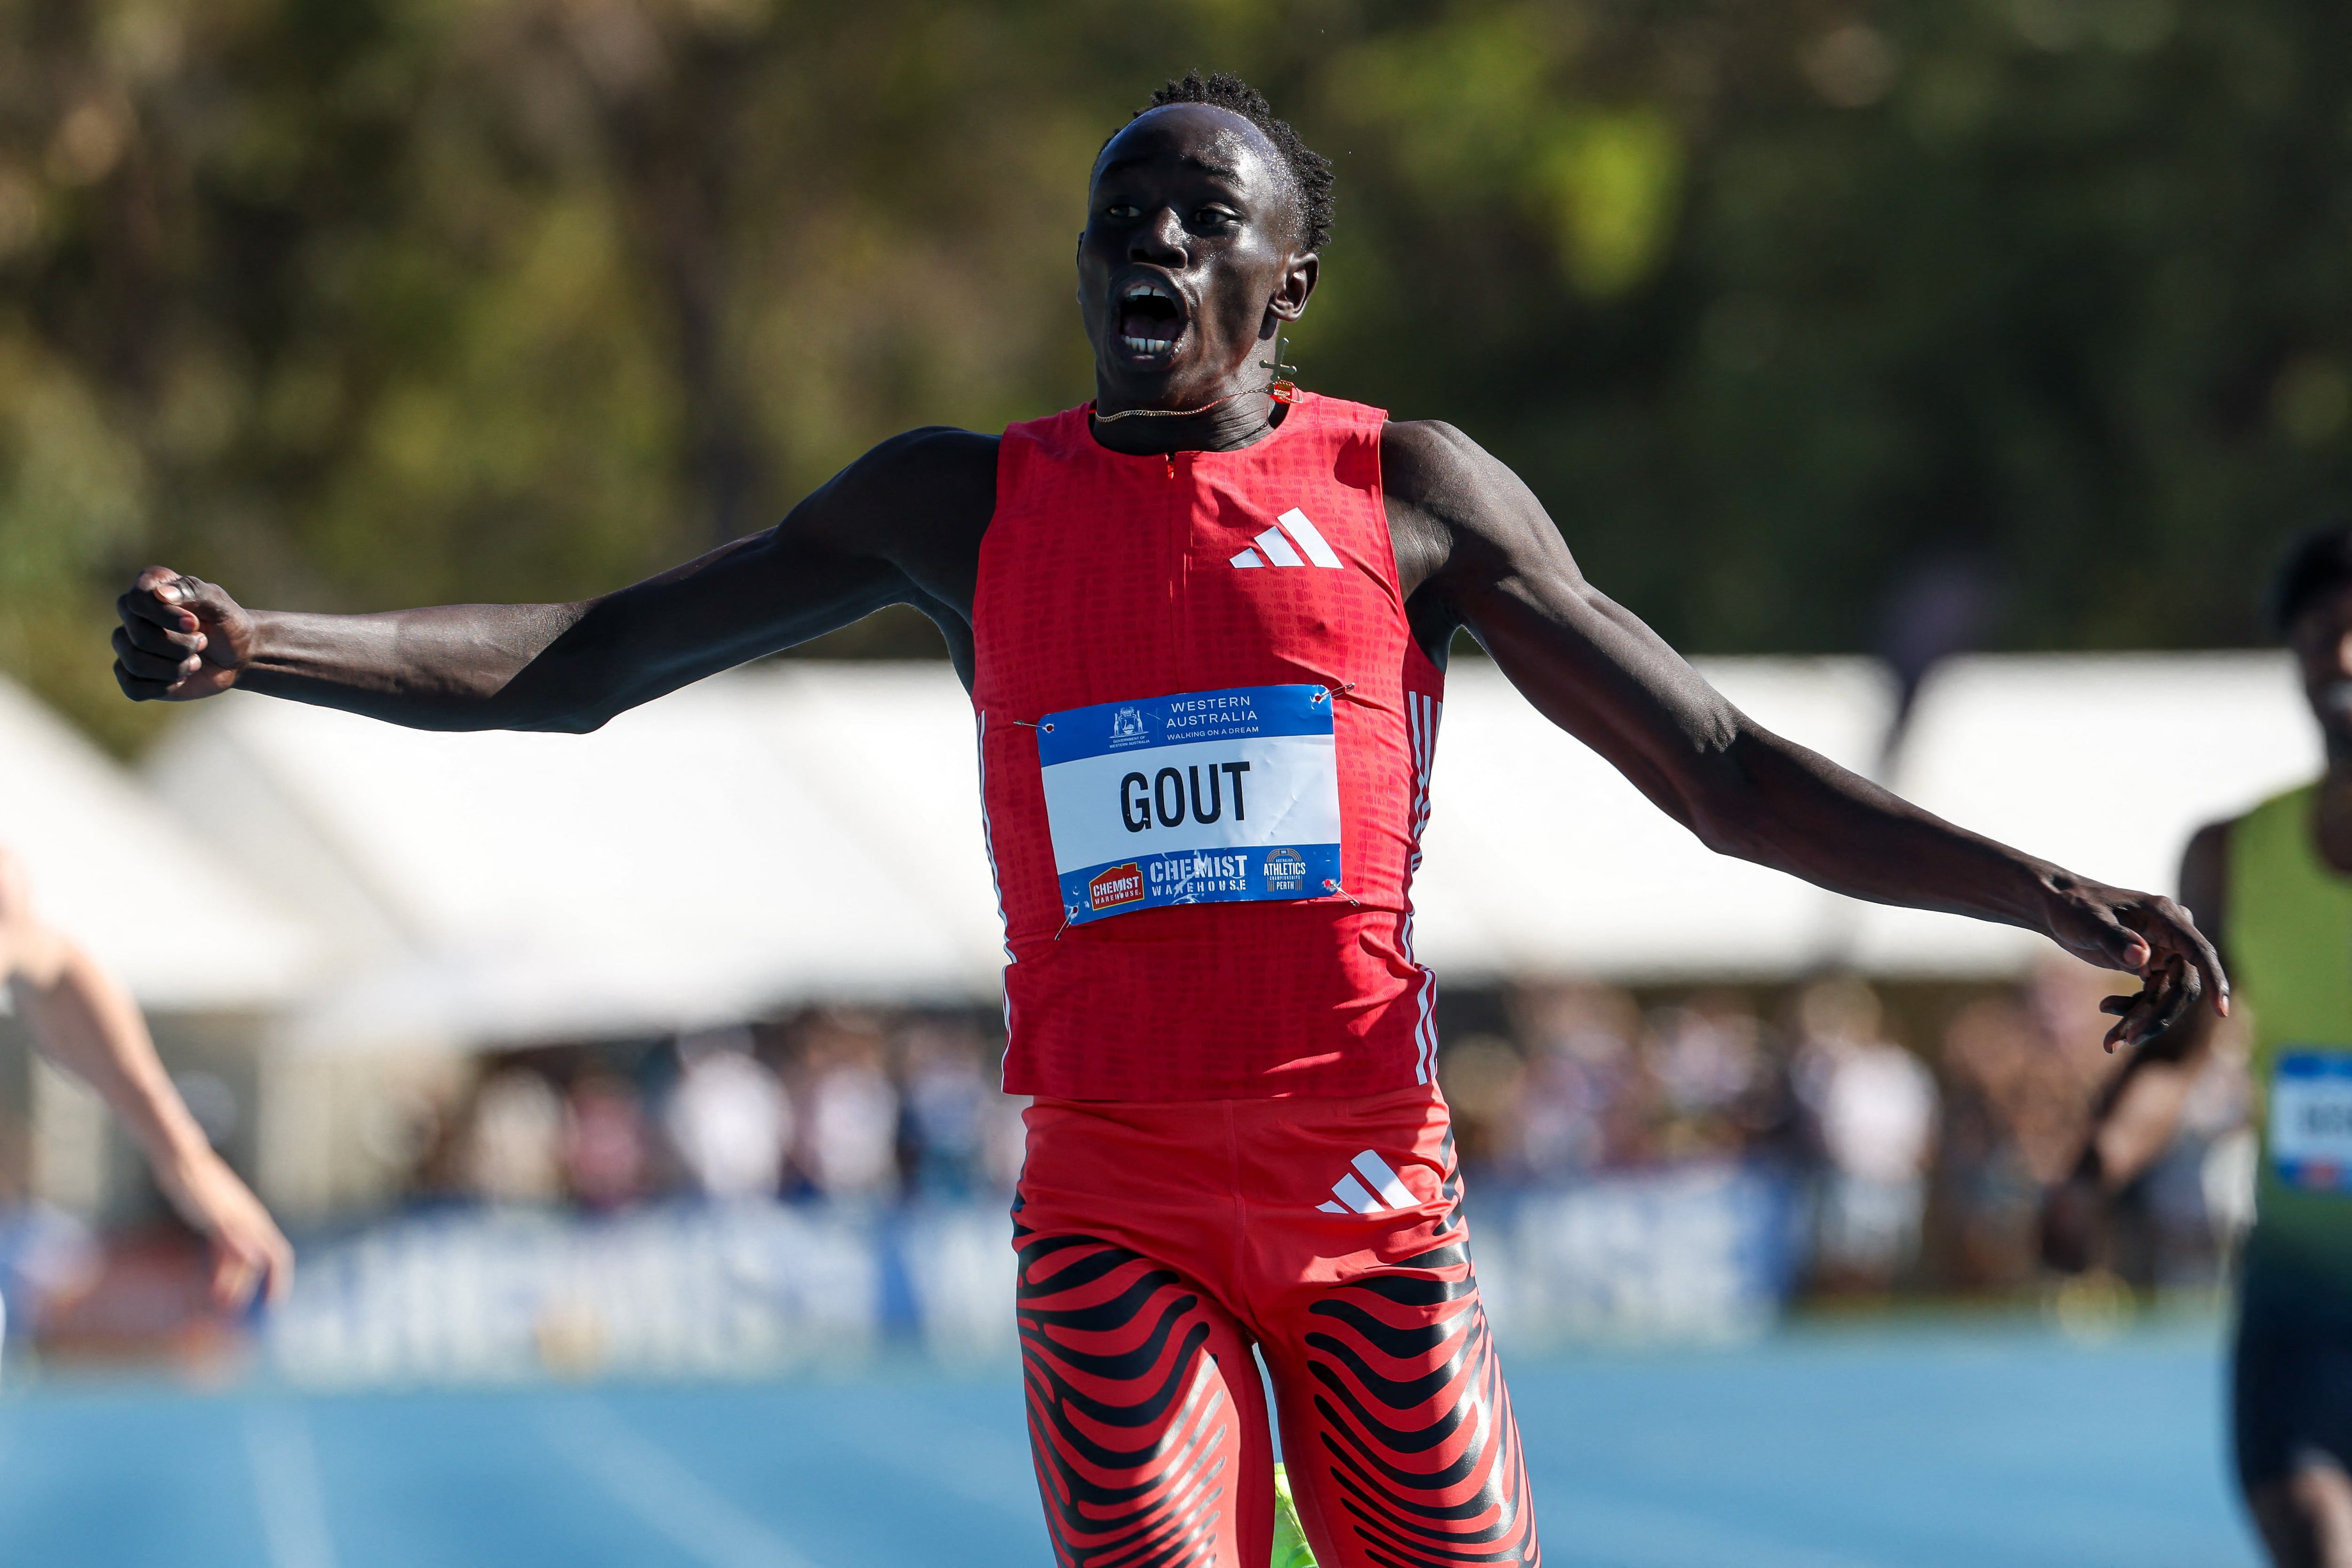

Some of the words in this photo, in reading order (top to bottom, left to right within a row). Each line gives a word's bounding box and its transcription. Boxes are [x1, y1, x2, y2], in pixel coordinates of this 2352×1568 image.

[1171, 696, 1250, 713] WESTERN
[1166, 710, 1258, 729] AUSTRALIA
[1167, 731, 1205, 740] WALKING
[1120, 761, 1250, 832] GOUT
[1150, 855, 1248, 883] CHEMIST
[1263, 862, 1306, 876] ATHLETICS
[1093, 876, 1139, 897] CHEMIST
[1276, 881, 1294, 890] PERTH
